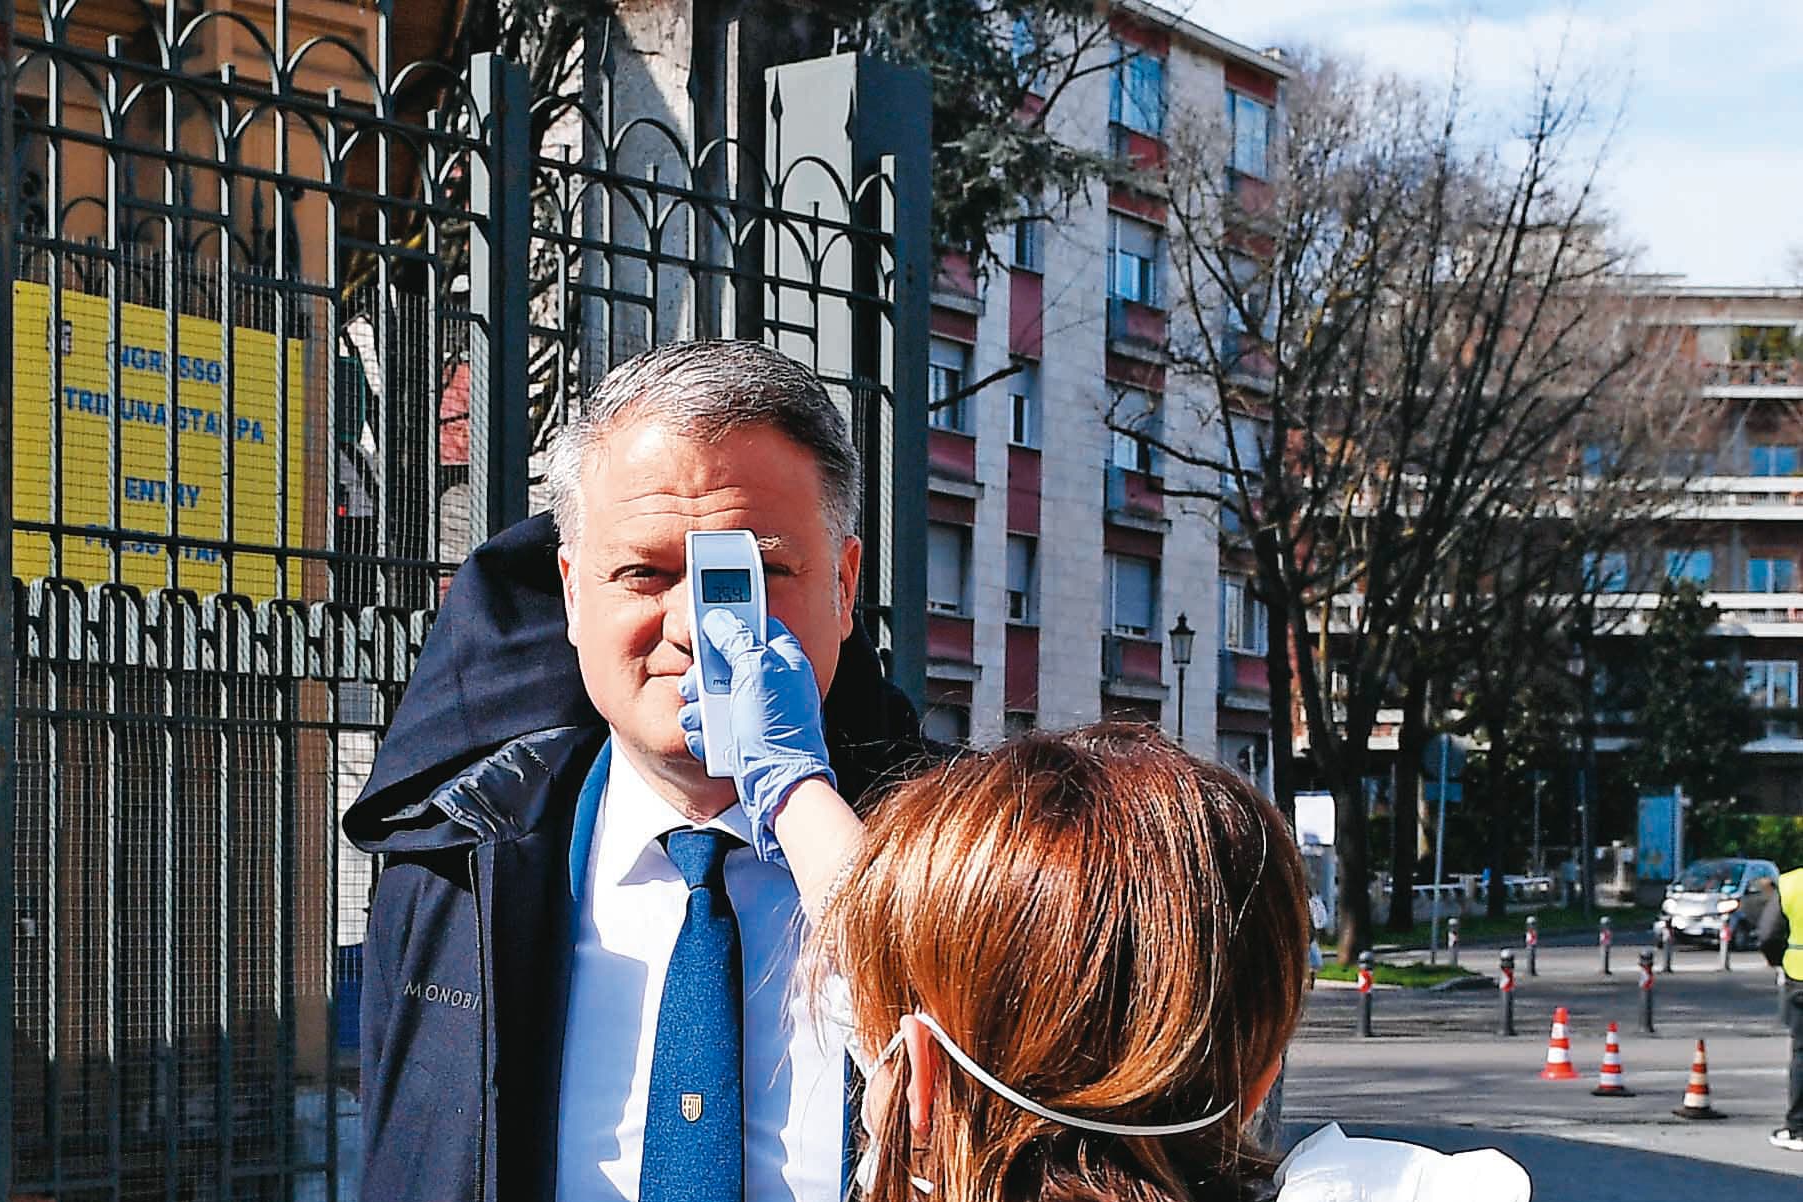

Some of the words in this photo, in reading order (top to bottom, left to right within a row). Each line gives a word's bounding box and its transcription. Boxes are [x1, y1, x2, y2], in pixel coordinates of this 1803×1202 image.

[106, 343, 222, 384] NGRSSO
[63, 385, 167, 426] TRIUNA
[176, 406, 265, 444] STAPA
[403, 980, 479, 1011] MONOBI
